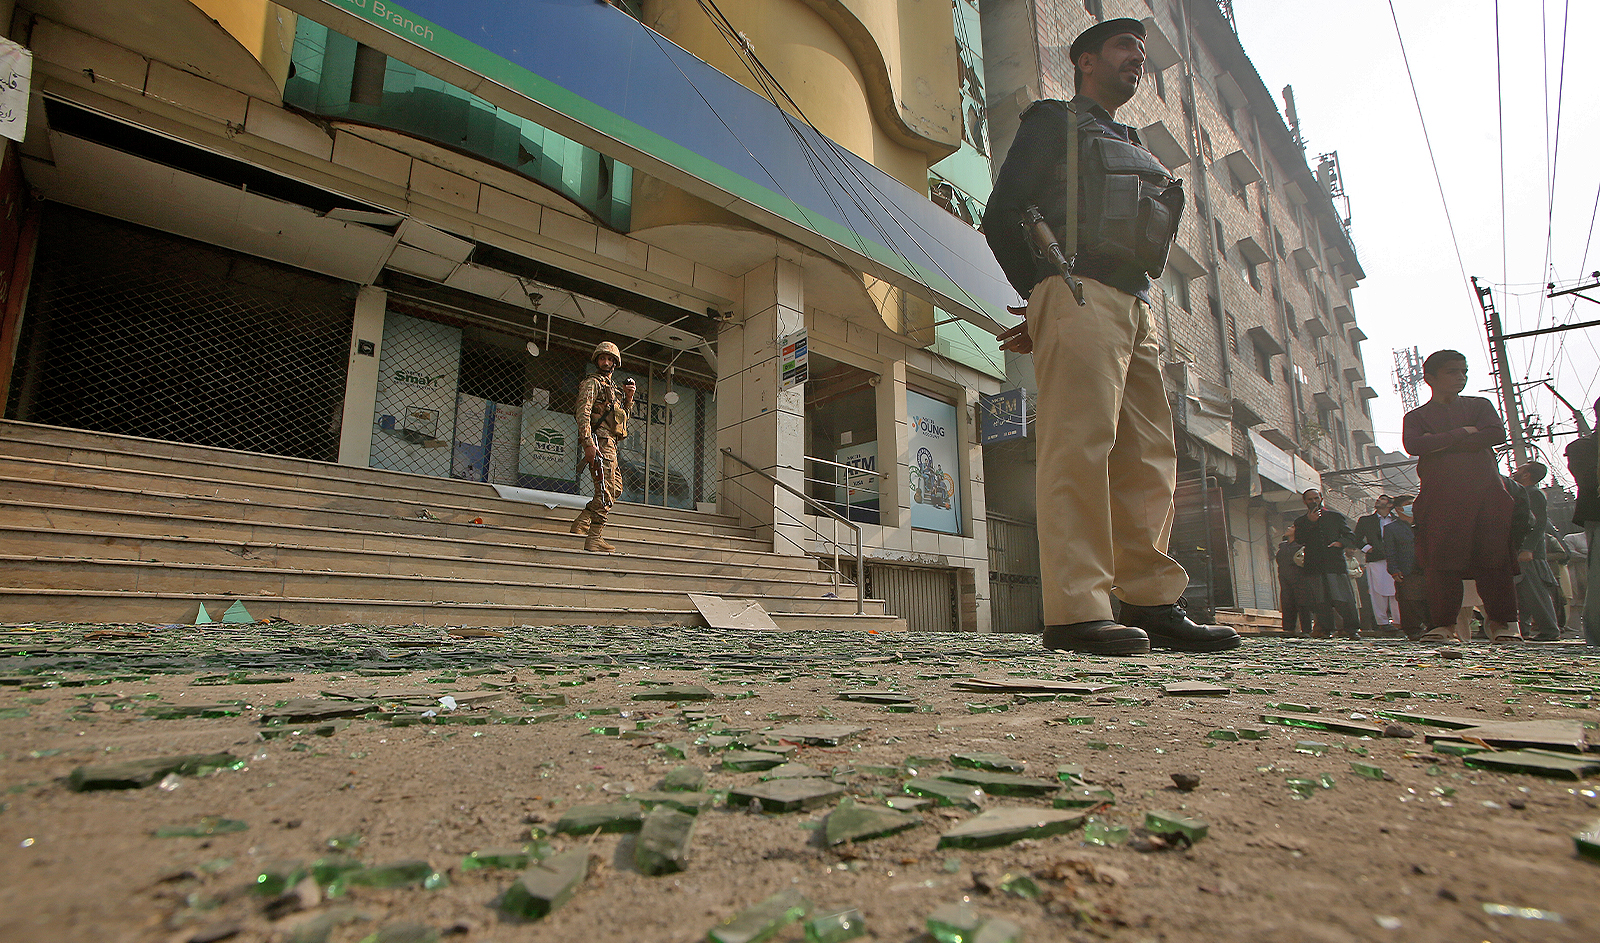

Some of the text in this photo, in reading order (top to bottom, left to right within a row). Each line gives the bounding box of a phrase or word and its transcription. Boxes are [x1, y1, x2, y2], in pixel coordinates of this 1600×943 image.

[373, 1, 434, 41] Branch
[394, 370, 445, 388] Smart
[990, 399, 1017, 415] ATM
[535, 442, 564, 453] MCB
[843, 455, 876, 477] ATM
